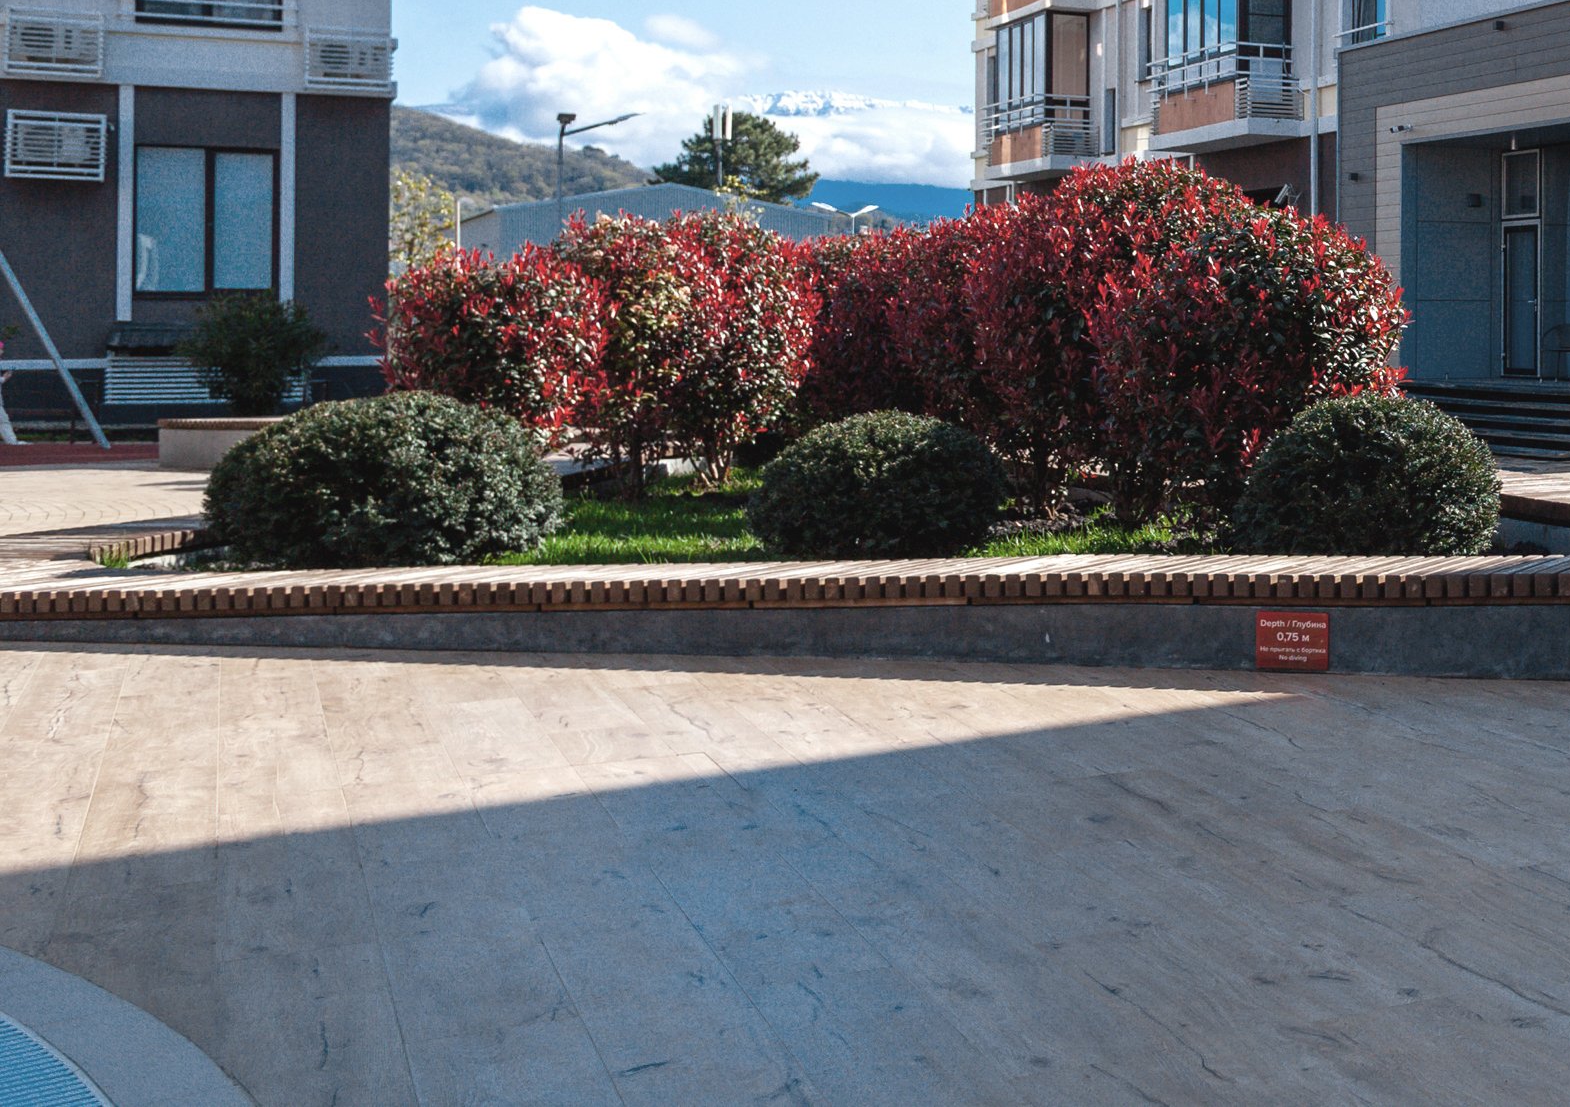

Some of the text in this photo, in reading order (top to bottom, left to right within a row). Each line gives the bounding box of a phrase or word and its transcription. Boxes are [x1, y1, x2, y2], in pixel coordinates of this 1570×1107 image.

[1260, 619, 1285, 628] Depth
[1292, 620, 1327, 629] Глубина
[1276, 632, 1299, 642] 0,75
